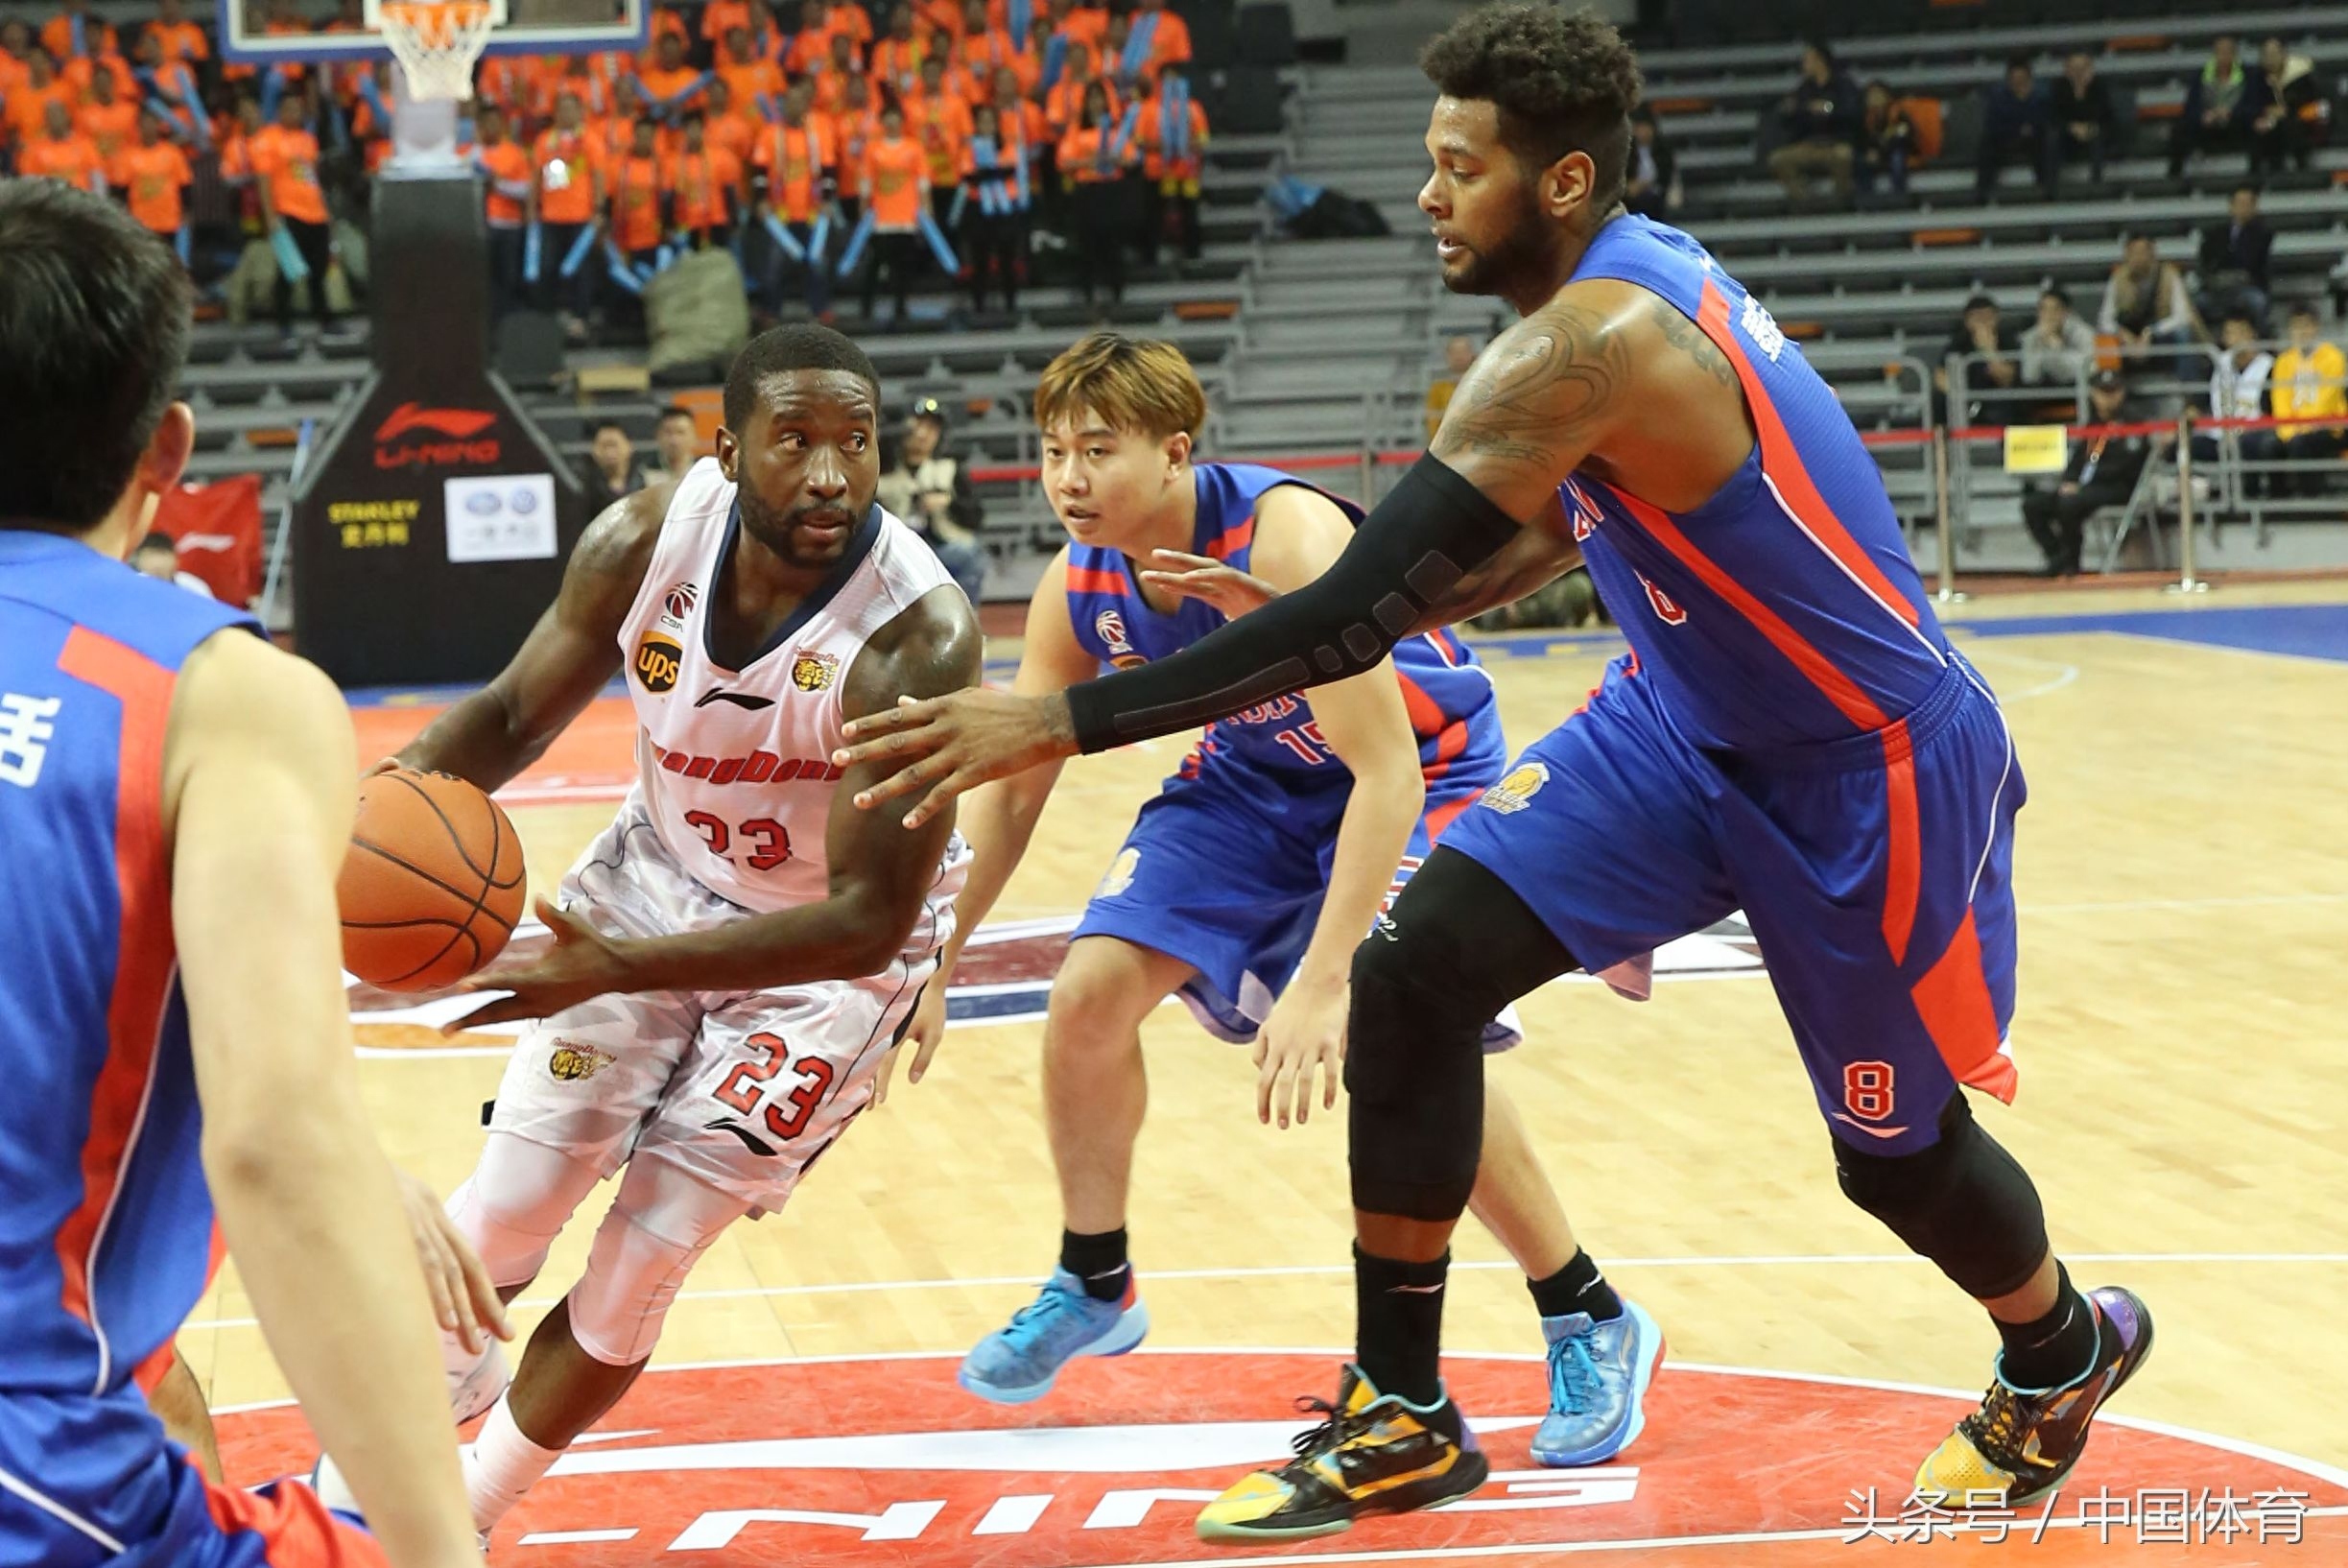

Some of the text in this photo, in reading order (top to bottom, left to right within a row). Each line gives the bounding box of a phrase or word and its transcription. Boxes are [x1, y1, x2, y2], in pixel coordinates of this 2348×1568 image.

[660, 615, 684, 632] CBA
[637, 647, 680, 685] ups
[712, 1031, 835, 1141] 23
[1843, 1059, 1894, 1121] 8
